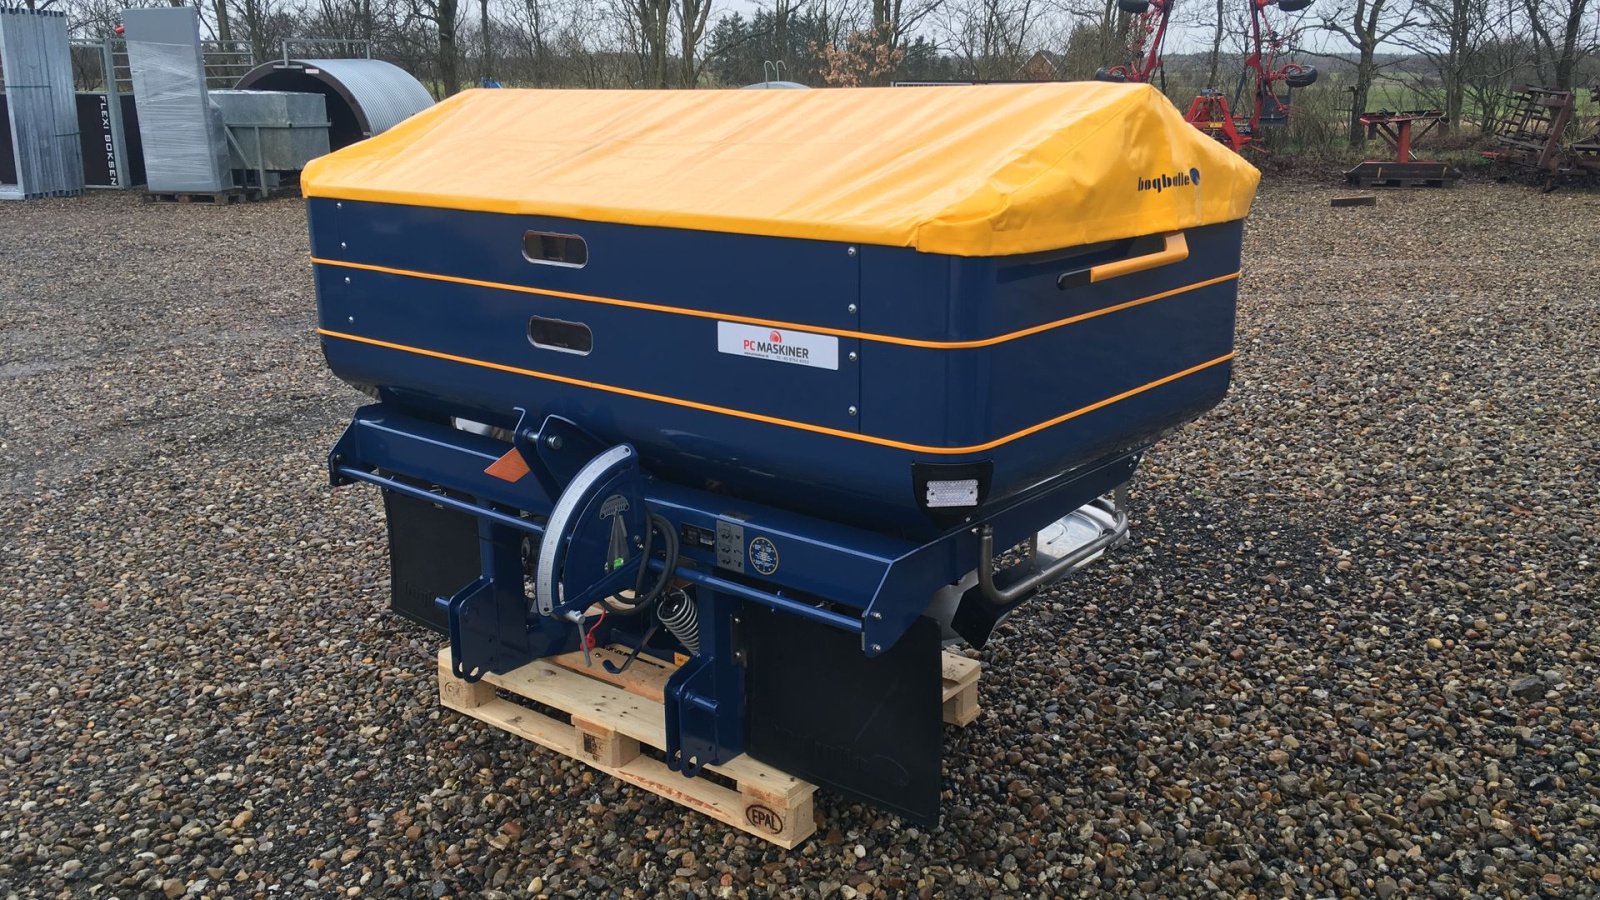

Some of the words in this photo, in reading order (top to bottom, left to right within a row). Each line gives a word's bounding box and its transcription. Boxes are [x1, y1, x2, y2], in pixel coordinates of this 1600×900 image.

[100, 95, 109, 129] FLEXI
[104, 134, 117, 186] BOKSEN
[743, 340, 756, 351] PC
[757, 341, 809, 359] MASKINER
[752, 809, 778, 831] EPAL
